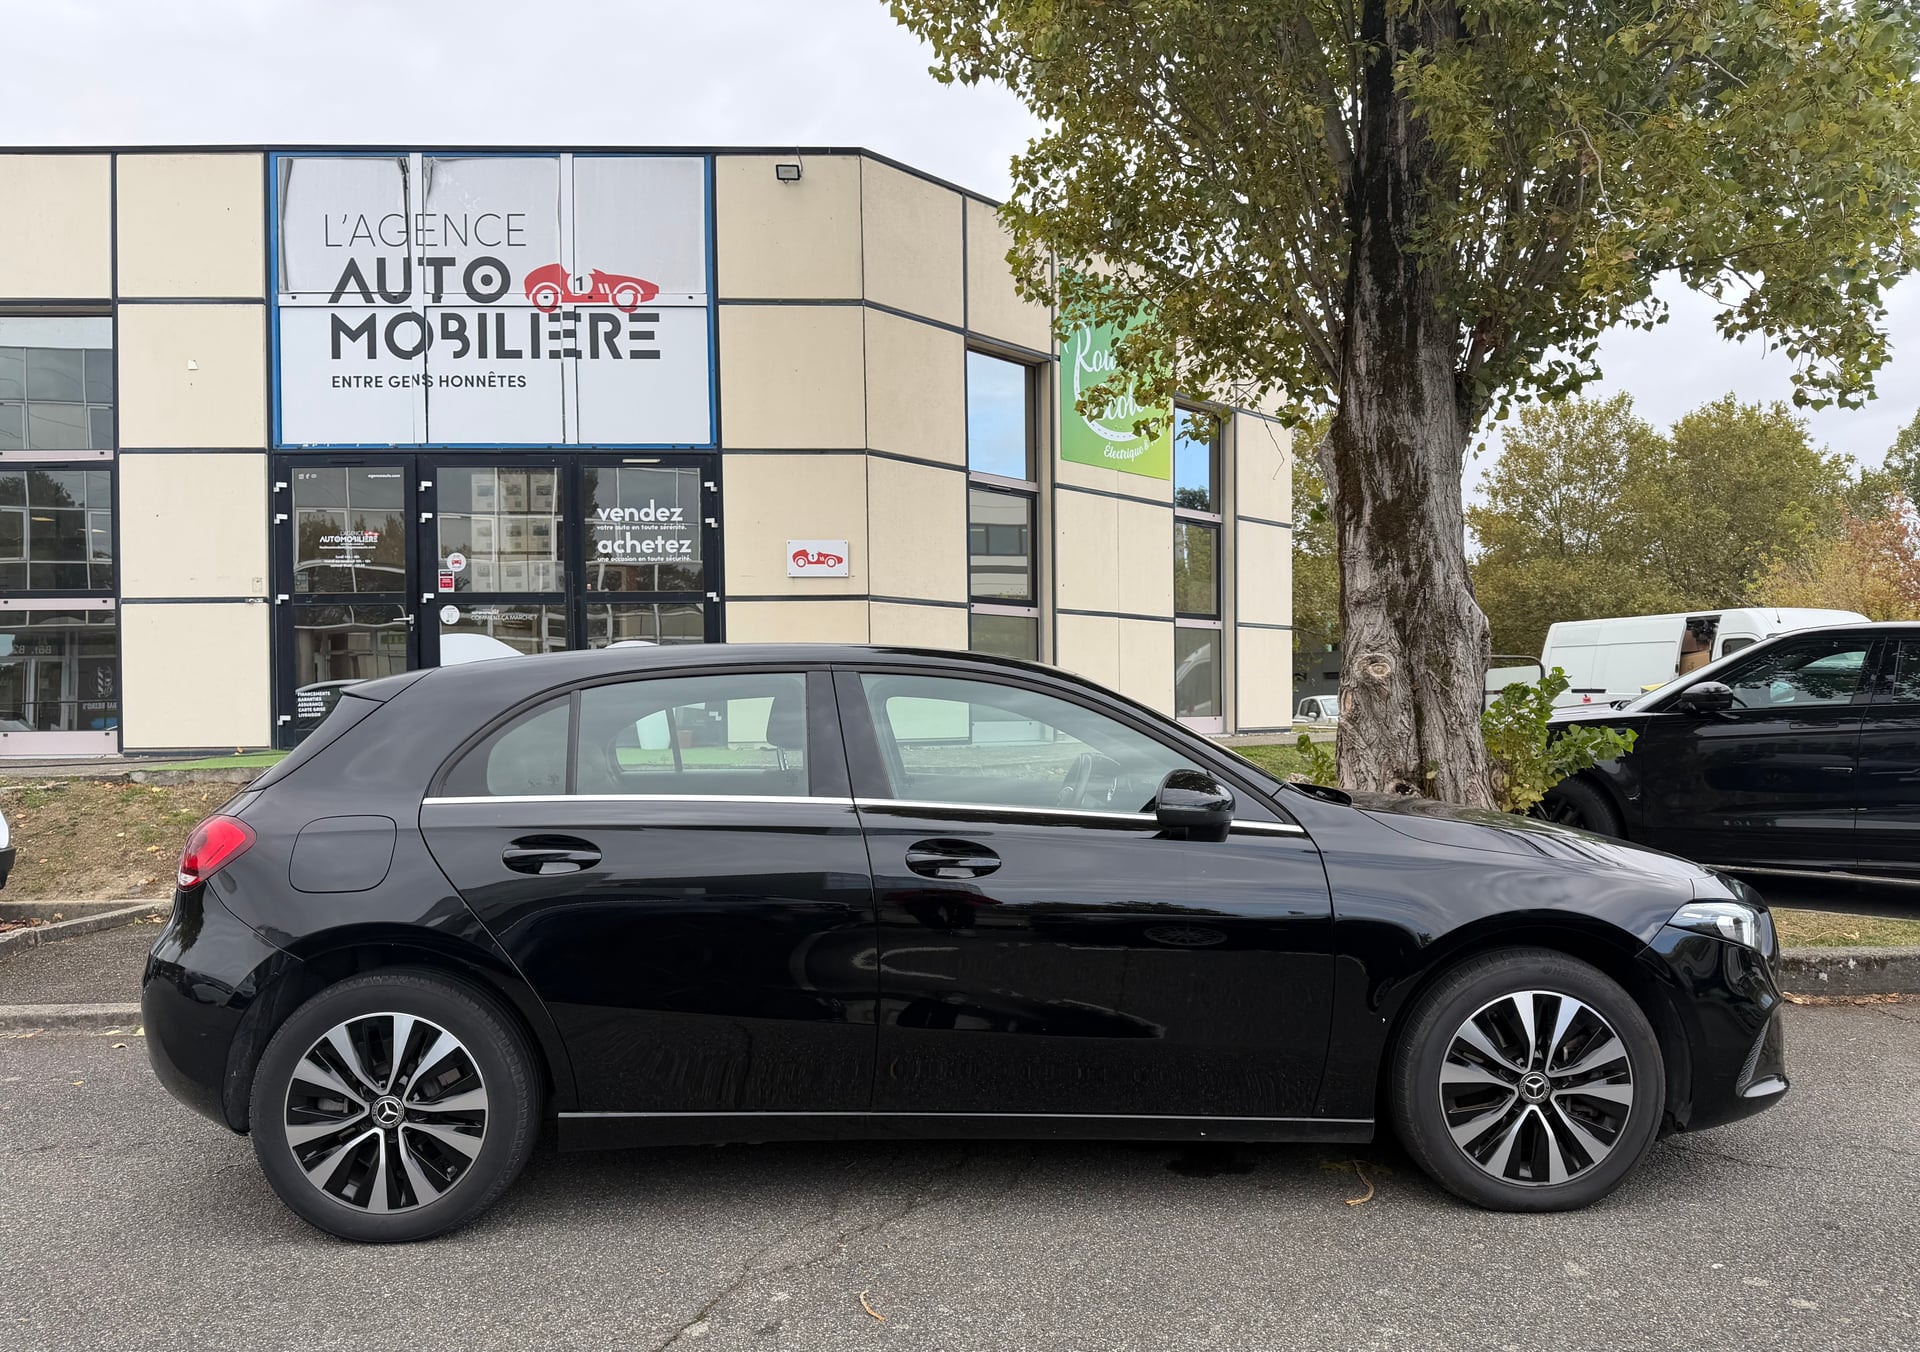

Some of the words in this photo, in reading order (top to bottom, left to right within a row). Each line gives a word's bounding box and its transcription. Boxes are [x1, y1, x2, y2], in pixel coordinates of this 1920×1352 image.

[328, 256, 512, 305] AUTO
[331, 375, 384, 389] ENTRE
[388, 373, 434, 389] GENS
[438, 371, 527, 389] HONNÊTES
[596, 499, 684, 522] vendez
[597, 531, 692, 553] achetez
